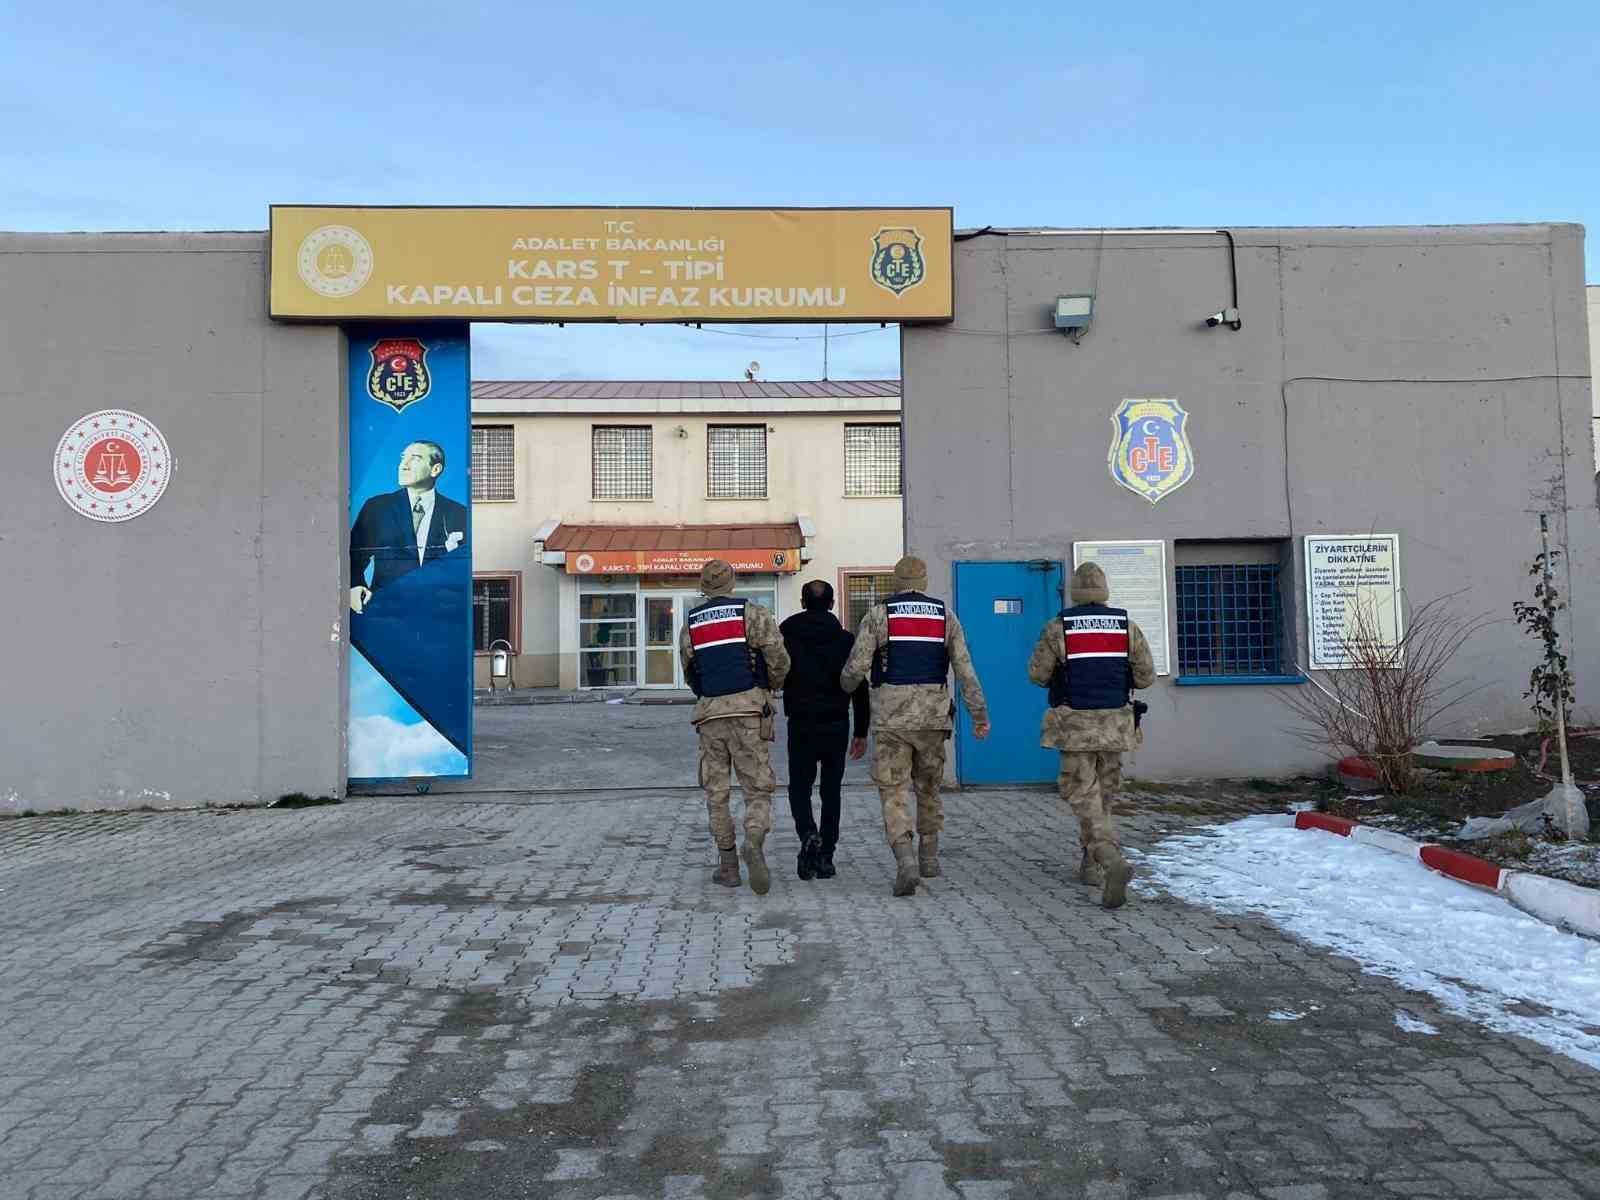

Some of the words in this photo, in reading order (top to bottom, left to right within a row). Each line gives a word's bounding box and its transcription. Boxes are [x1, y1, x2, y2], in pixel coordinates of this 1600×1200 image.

[512, 238, 600, 251] ADALET
[606, 235, 725, 251] BAKANLIĞI
[507, 260, 599, 280] KARS
[608, 260, 630, 280] T
[663, 255, 724, 280] TİPİ
[386, 285, 502, 305] KAPALI
[511, 285, 600, 306] CEZA
[607, 281, 700, 306] İNFAZ
[709, 287, 847, 307] KURUMU
[386, 372, 413, 391] CTE
[1130, 436, 1175, 473] CTE
[1314, 544, 1388, 554] ZİYARETÇİLERİN
[1327, 554, 1376, 563] DİKKATİNE
[694, 608, 737, 624] JANDARMA
[894, 604, 940, 616] JANDARMA
[1072, 618, 1121, 631] JANDARMA
